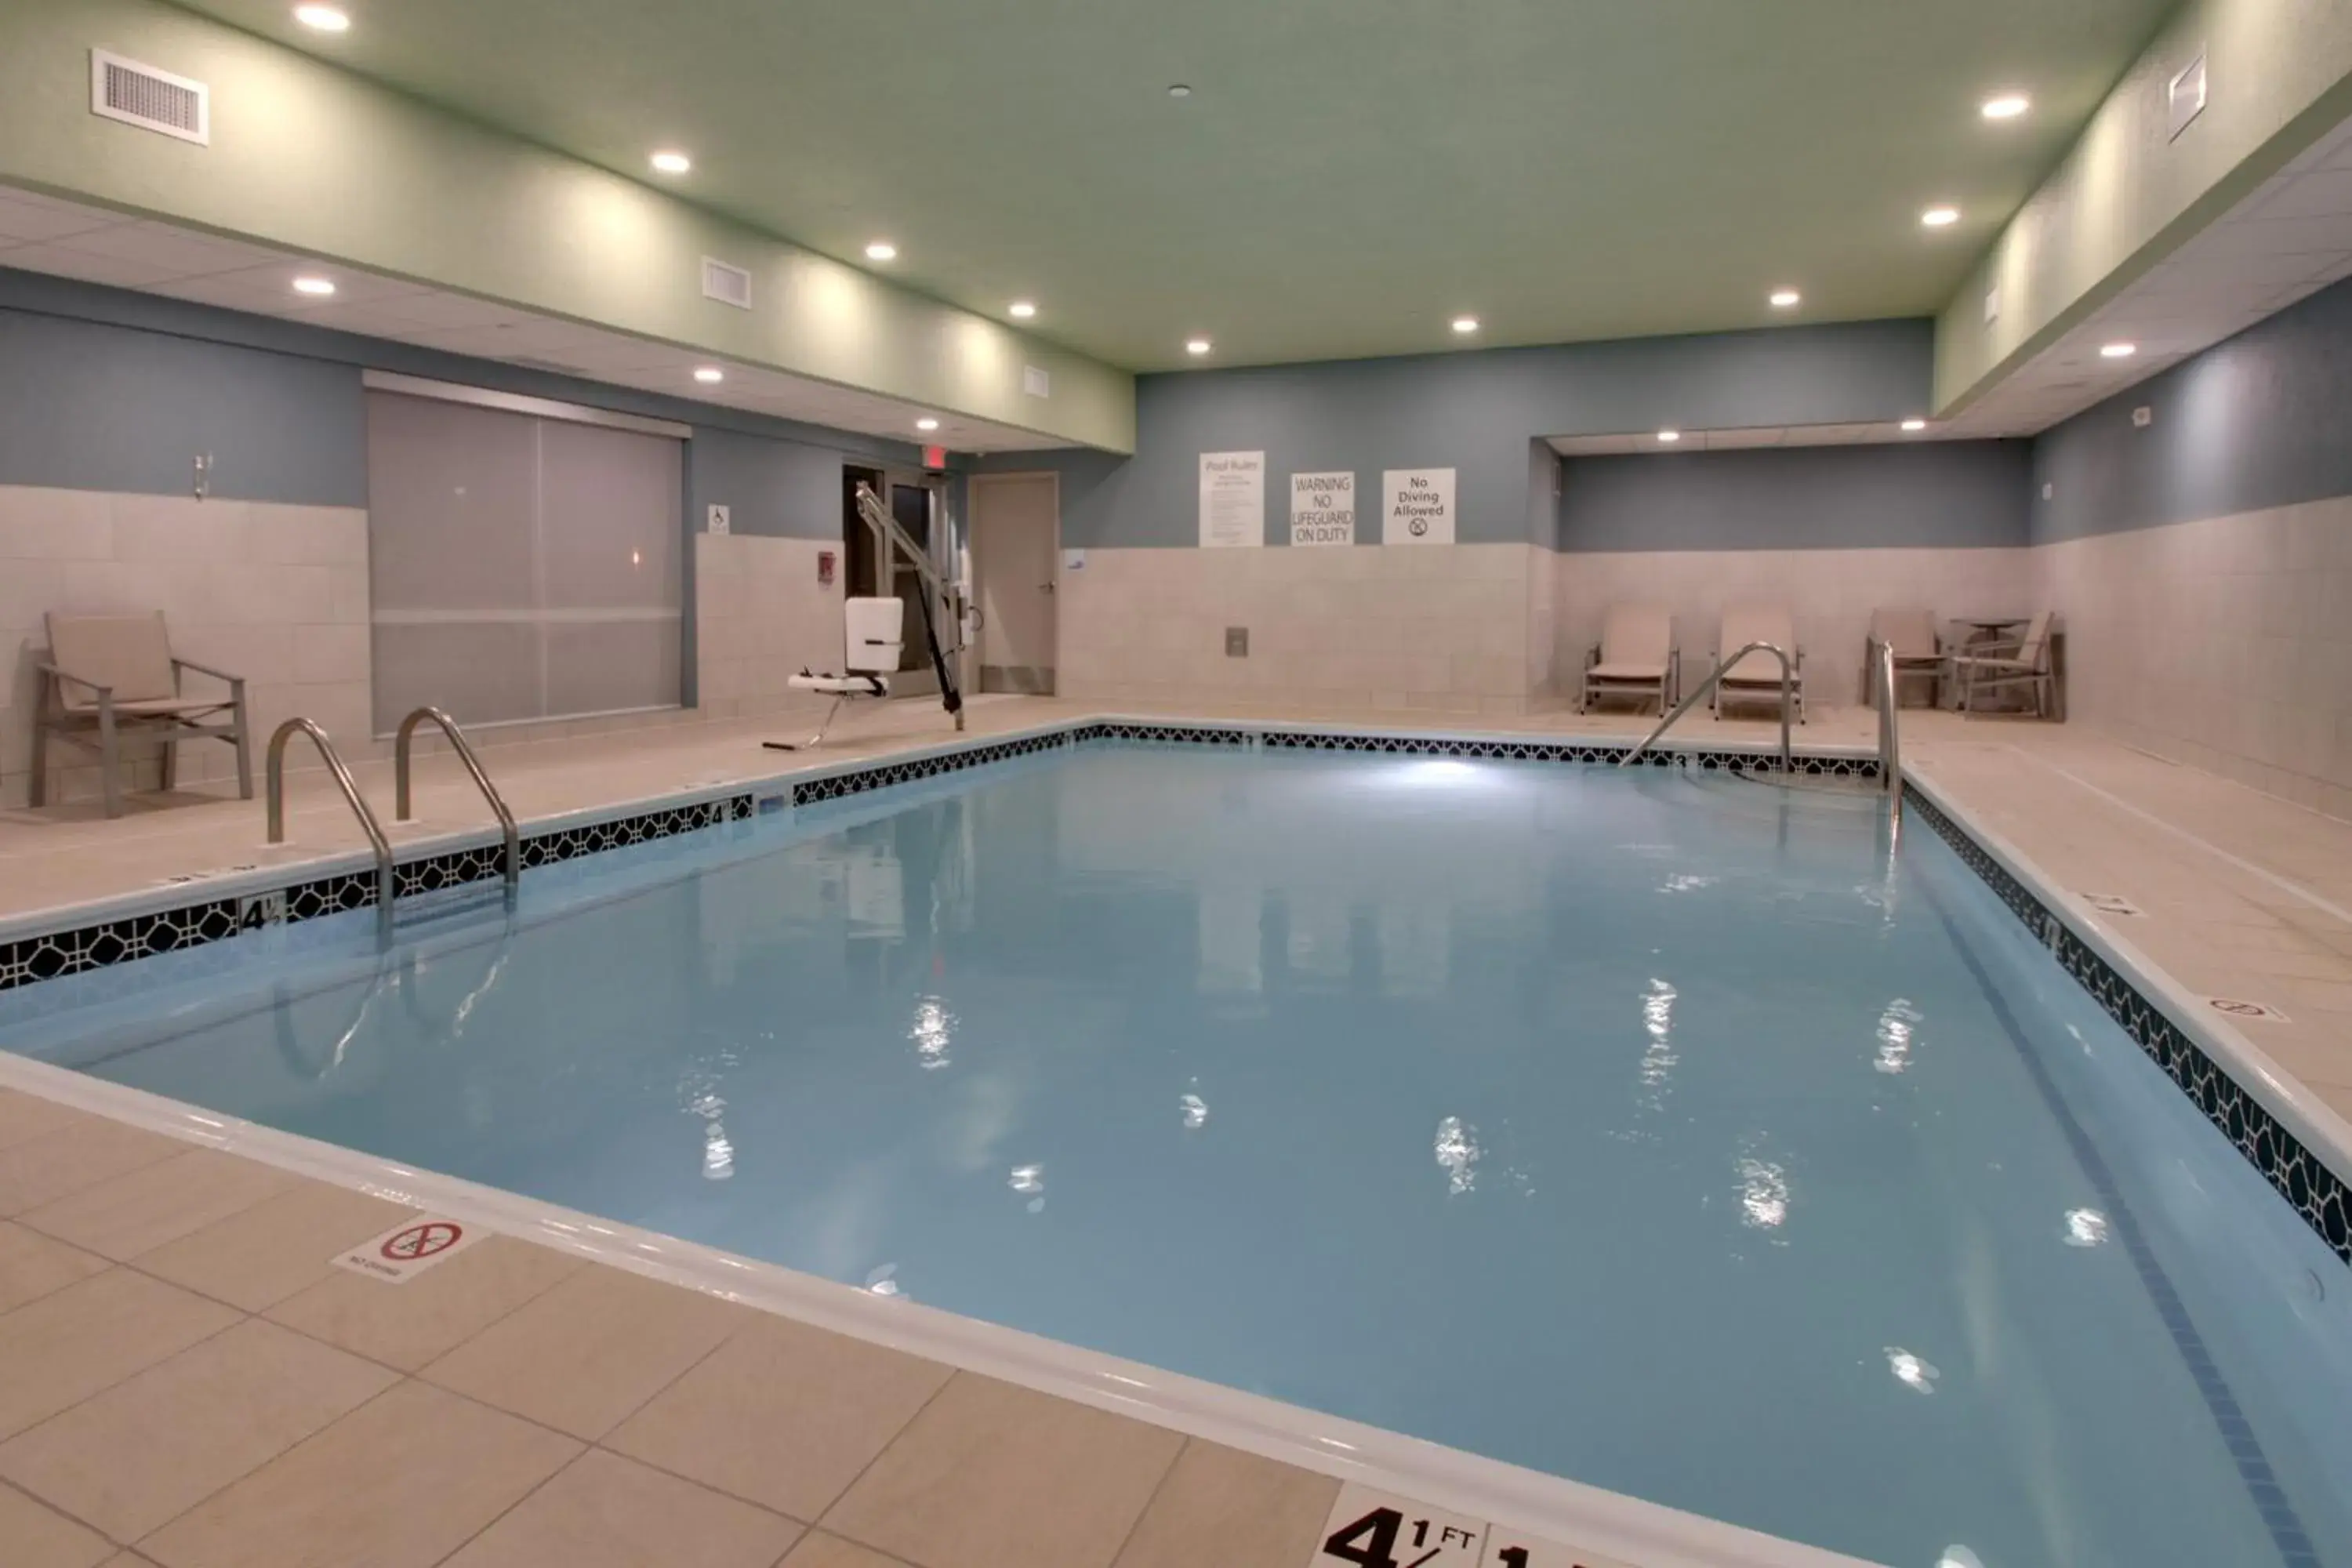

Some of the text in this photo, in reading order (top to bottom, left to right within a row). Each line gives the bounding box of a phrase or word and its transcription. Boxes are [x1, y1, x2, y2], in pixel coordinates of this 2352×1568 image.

[1296, 476, 1351, 492] WARNING
[1410, 476, 1428, 488] No
[1313, 494, 1332, 509] NO
[1399, 491, 1439, 505] Diving
[1292, 510, 1354, 525] LIFEGUARD
[1393, 505, 1444, 517] Allowed
[1296, 527, 1347, 543] ON DUTY
[1441, 1526, 1475, 1549] FT
